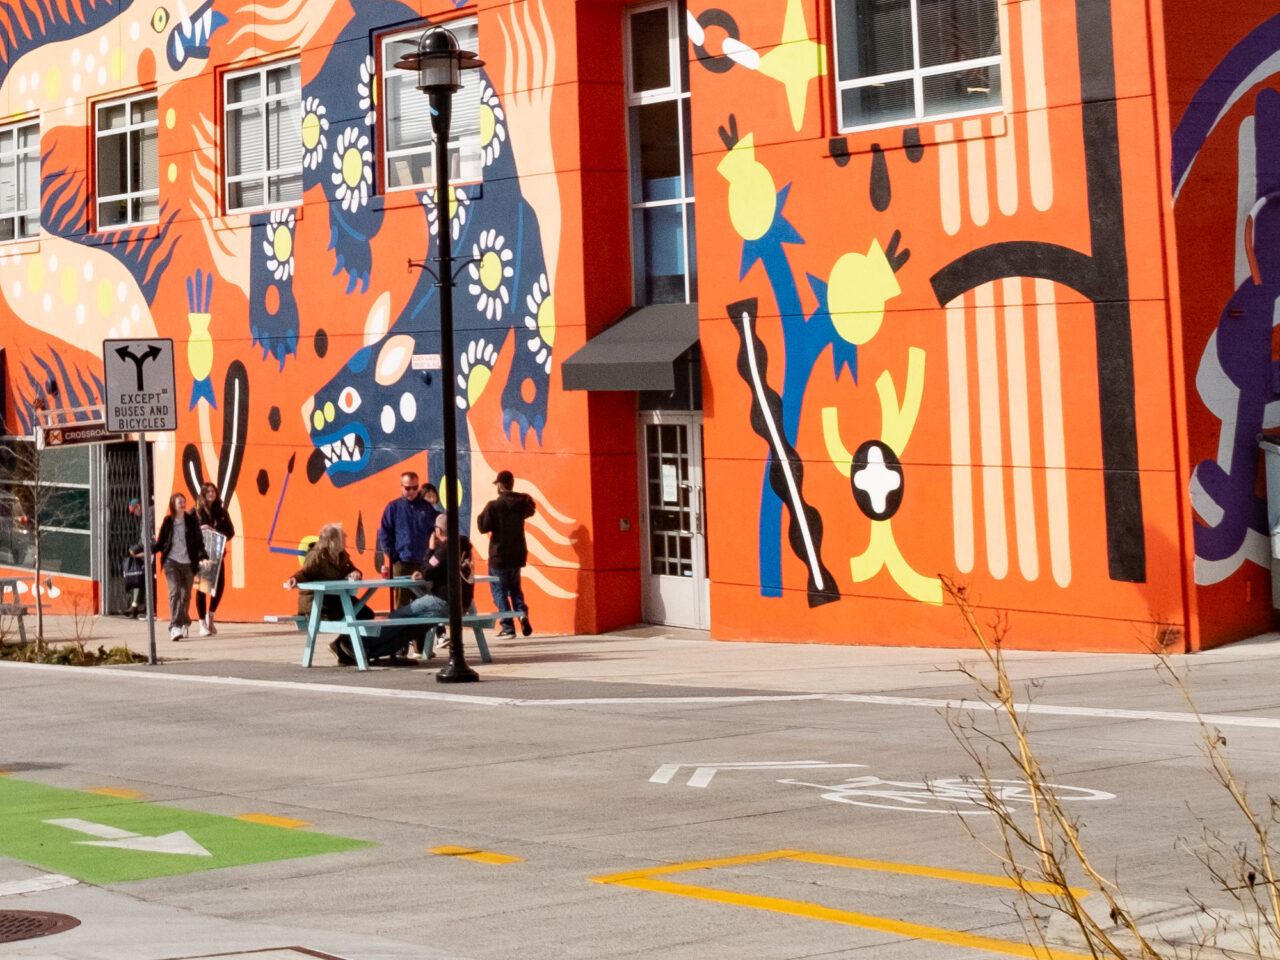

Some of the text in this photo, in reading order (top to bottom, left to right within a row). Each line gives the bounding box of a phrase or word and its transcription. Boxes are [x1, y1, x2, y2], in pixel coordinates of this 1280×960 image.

[120, 393, 161, 405] EXCEPT
[114, 405, 169, 418] BUSES AND
[118, 417, 166, 430] BICYCLES
[64, 429, 108, 440] CROSSROA
